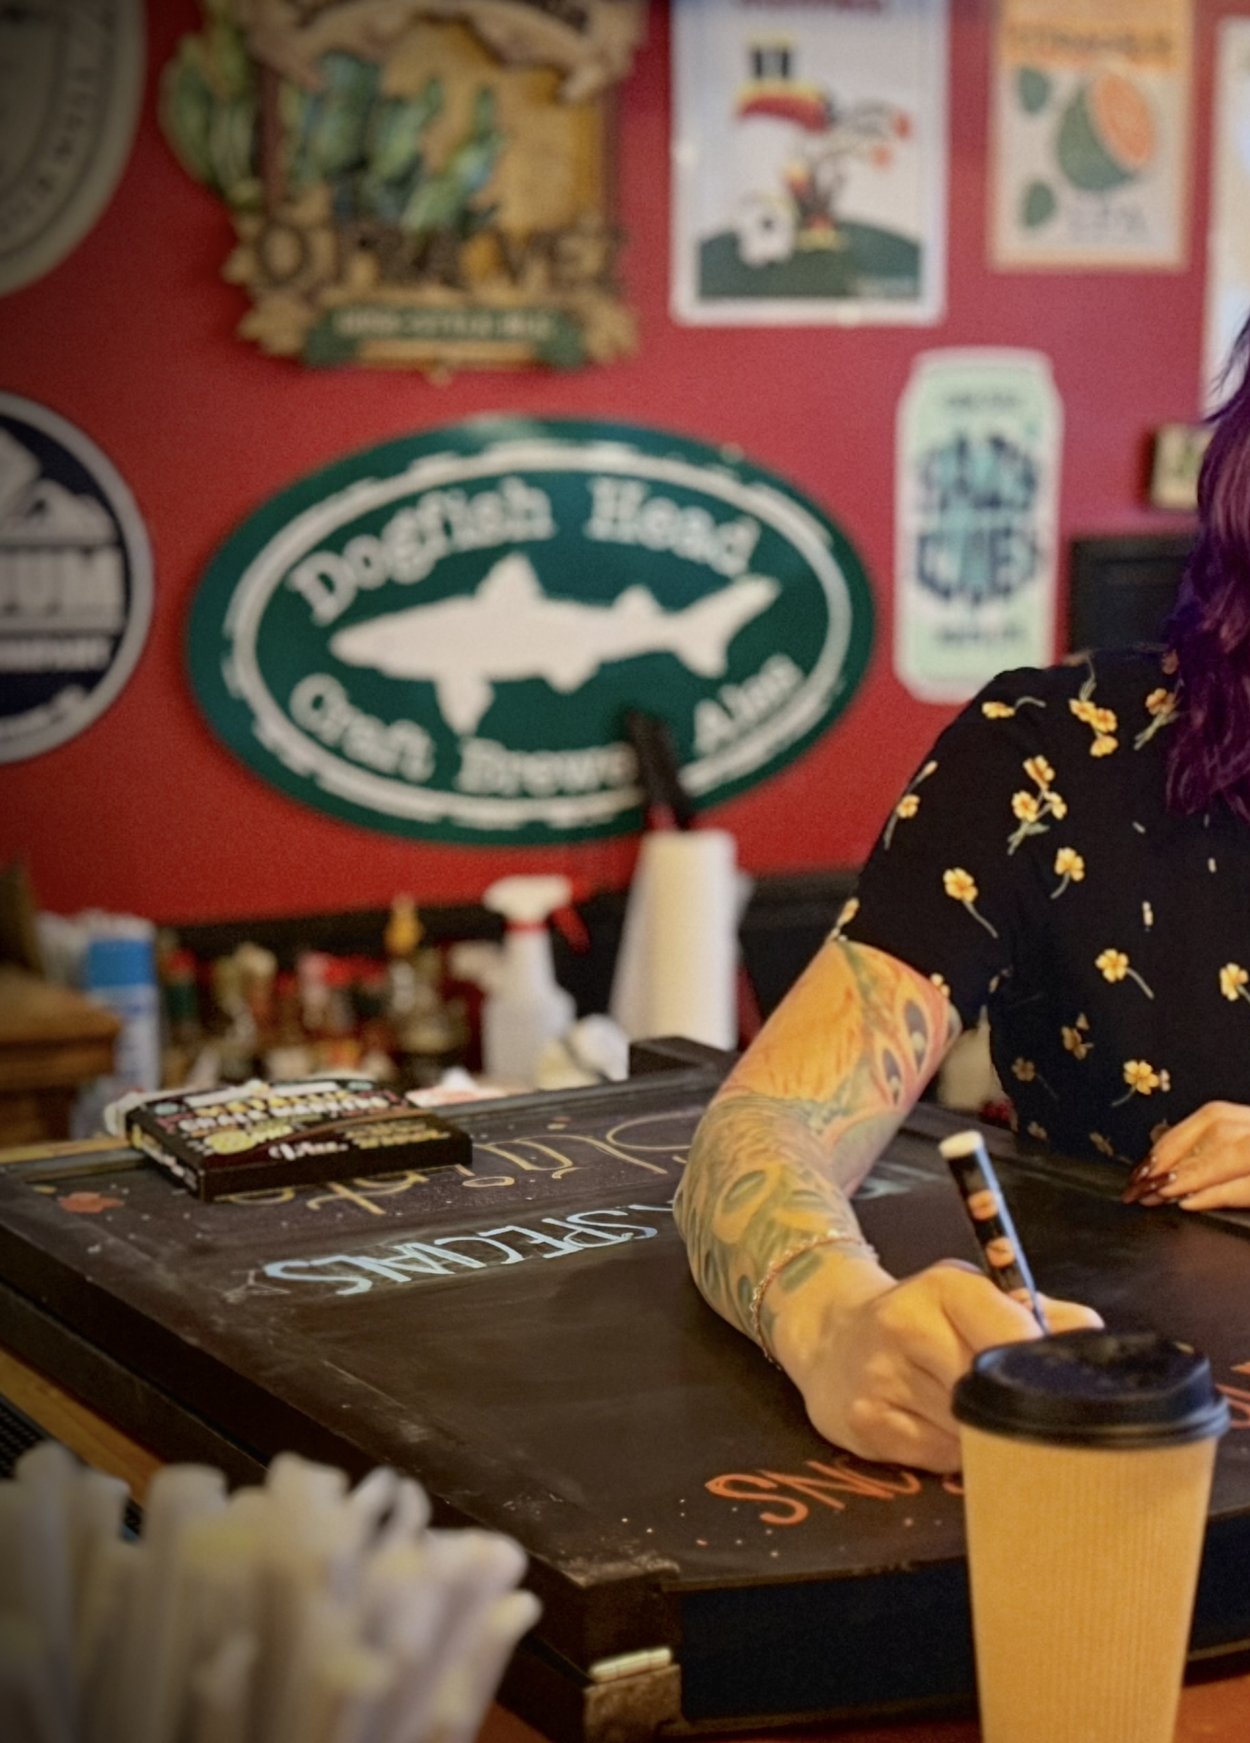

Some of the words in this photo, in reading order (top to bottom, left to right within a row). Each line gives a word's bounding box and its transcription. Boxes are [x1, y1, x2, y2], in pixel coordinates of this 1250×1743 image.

[287, 477, 556, 627] Dogfish
[585, 476, 761, 578] Head
[289, 672, 436, 783] Craft
[456, 737, 641, 798] Brewe
[692, 653, 806, 758] Ales
[262, 1207, 659, 1297] SPECIALS
